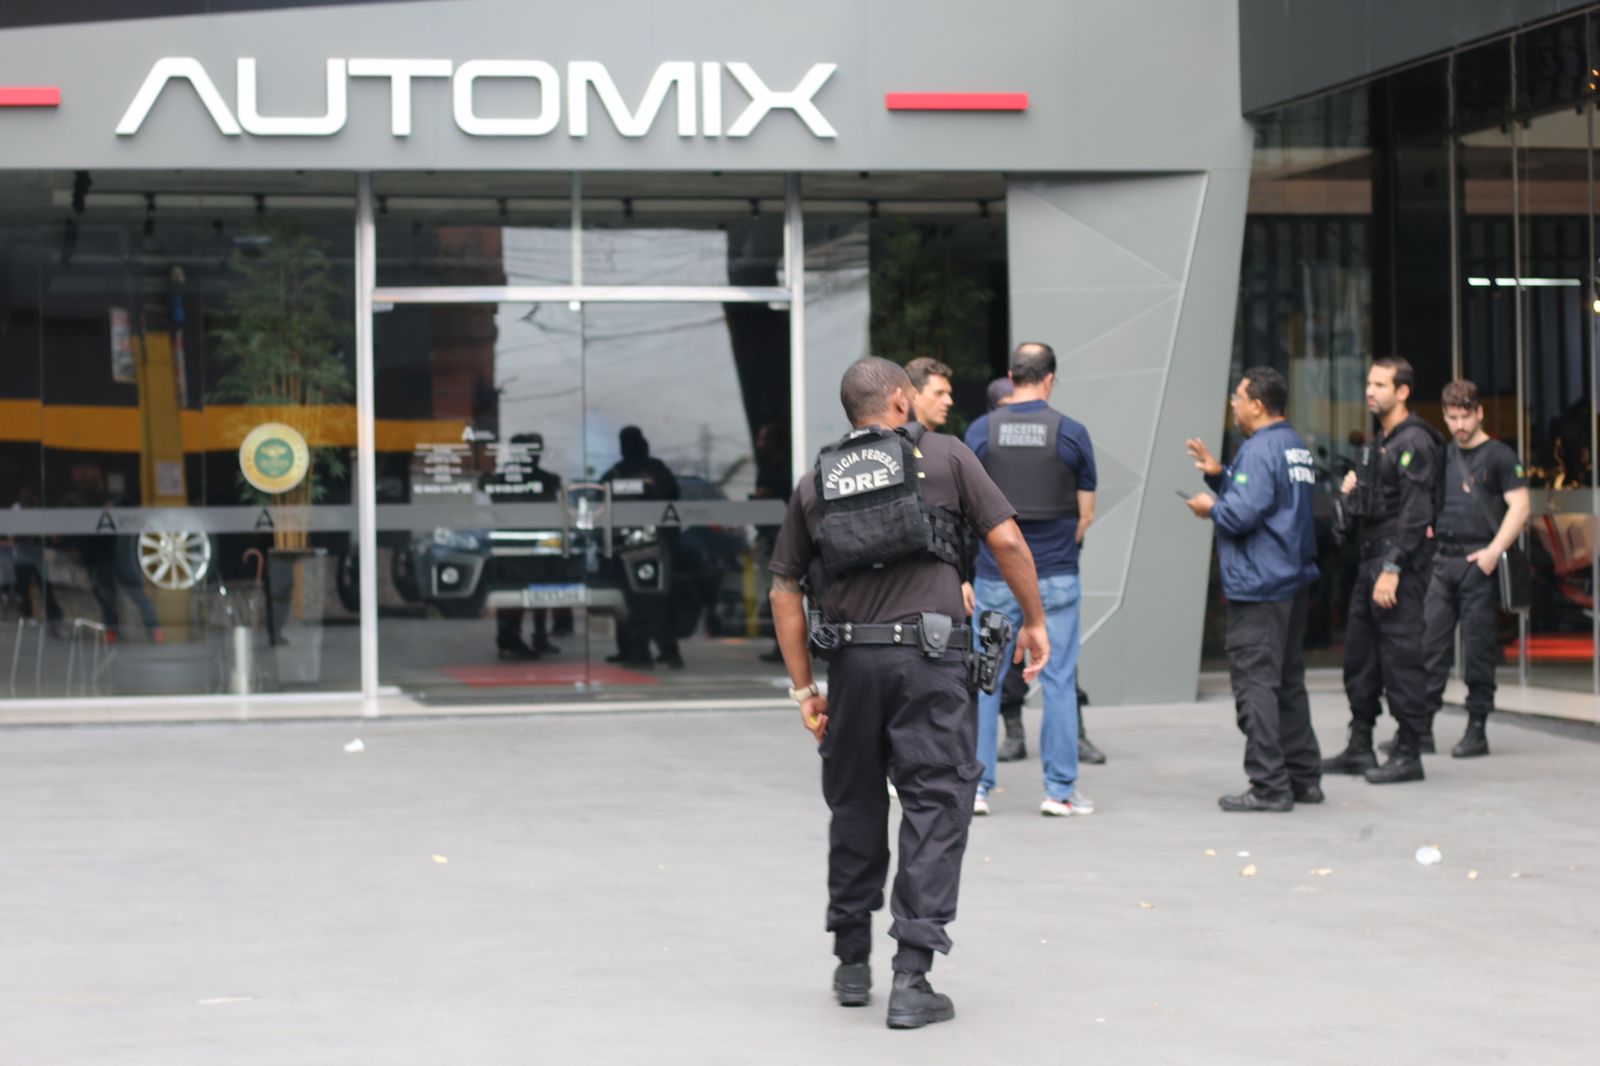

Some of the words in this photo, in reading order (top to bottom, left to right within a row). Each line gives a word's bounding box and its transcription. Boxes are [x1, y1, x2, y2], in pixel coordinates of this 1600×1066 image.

[115, 57, 839, 140] AUTOMIX
[999, 423, 1045, 434] RECEITA
[999, 435, 1045, 446] FEDERAL
[861, 449, 900, 475] FEDERAL
[838, 468, 890, 496] DRE
